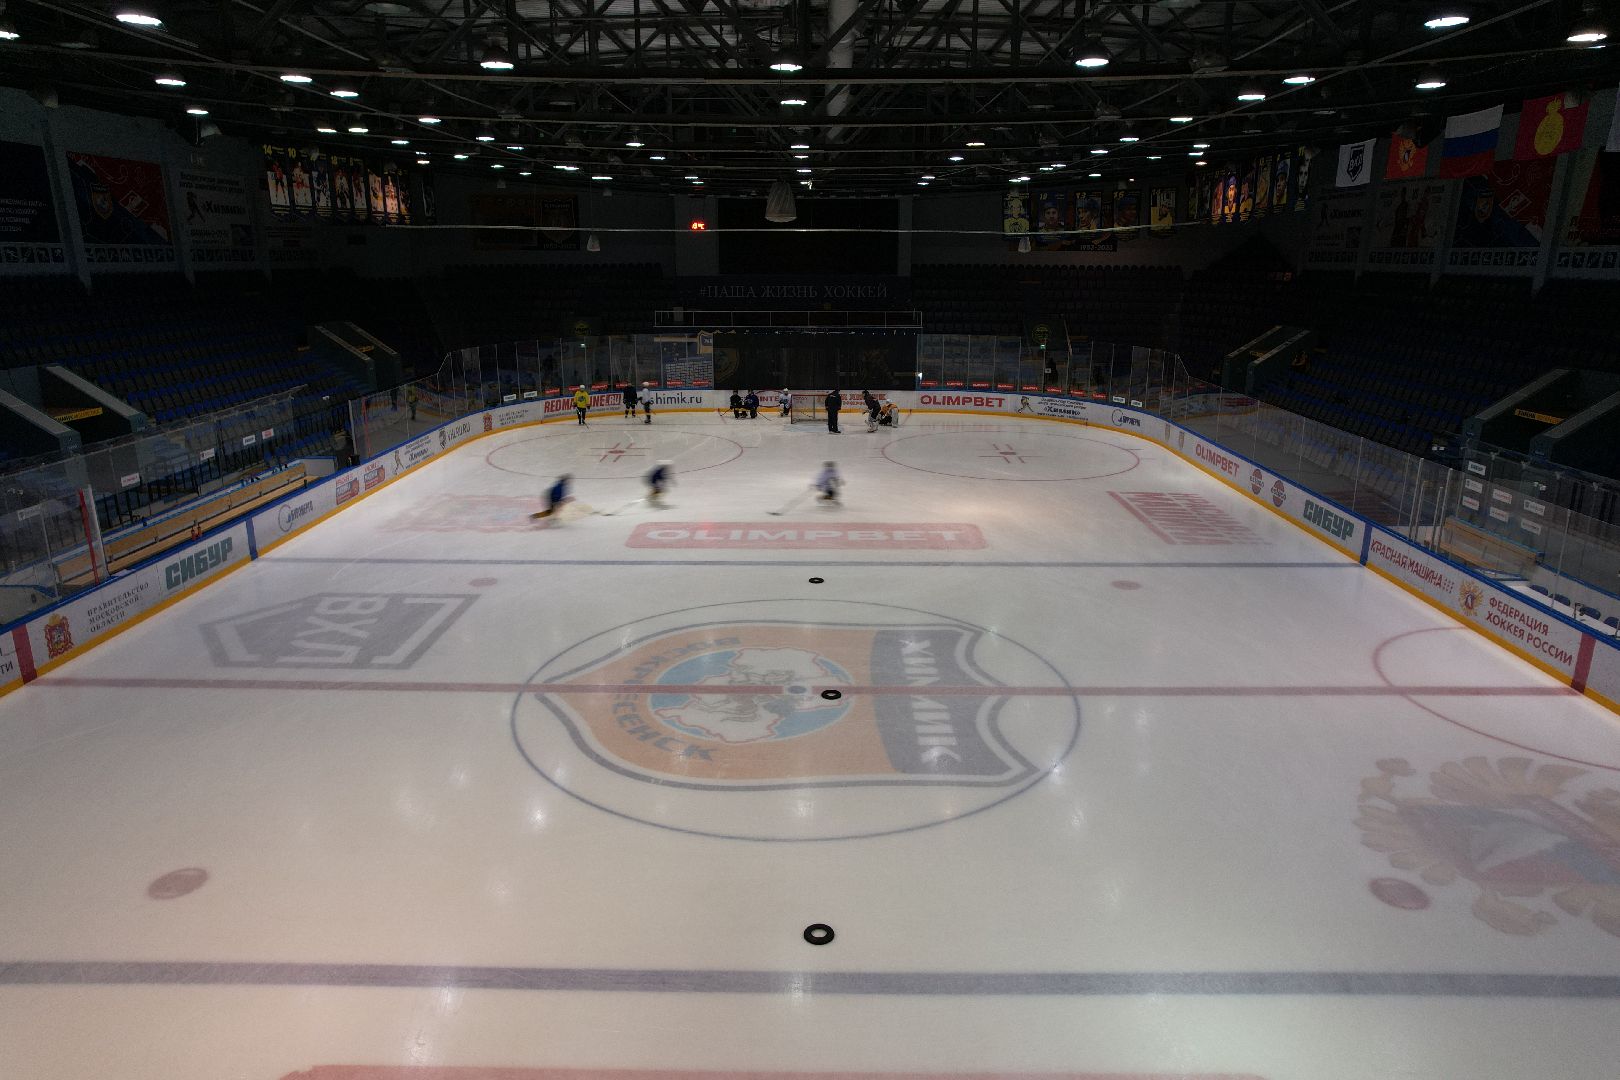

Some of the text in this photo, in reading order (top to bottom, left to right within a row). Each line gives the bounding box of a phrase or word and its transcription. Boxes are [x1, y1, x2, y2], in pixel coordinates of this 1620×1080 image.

[700, 282, 888, 298] #НАША ЖИЗНЬ ХОККЕЙ
[920, 395, 1006, 408] OLIMPBET
[1195, 443, 1240, 478] OLIMPBET
[645, 528, 961, 542] OLIMPBET
[1303, 499, 1355, 541] СИБУР
[165, 537, 233, 590] СИБУР
[1370, 539, 1409, 569] КРАСНАЯ
[1488, 596, 1550, 636] ФЕДЕРАЦИЯ
[1485, 612, 1574, 667] ХОККЕЯ РОССИИ
